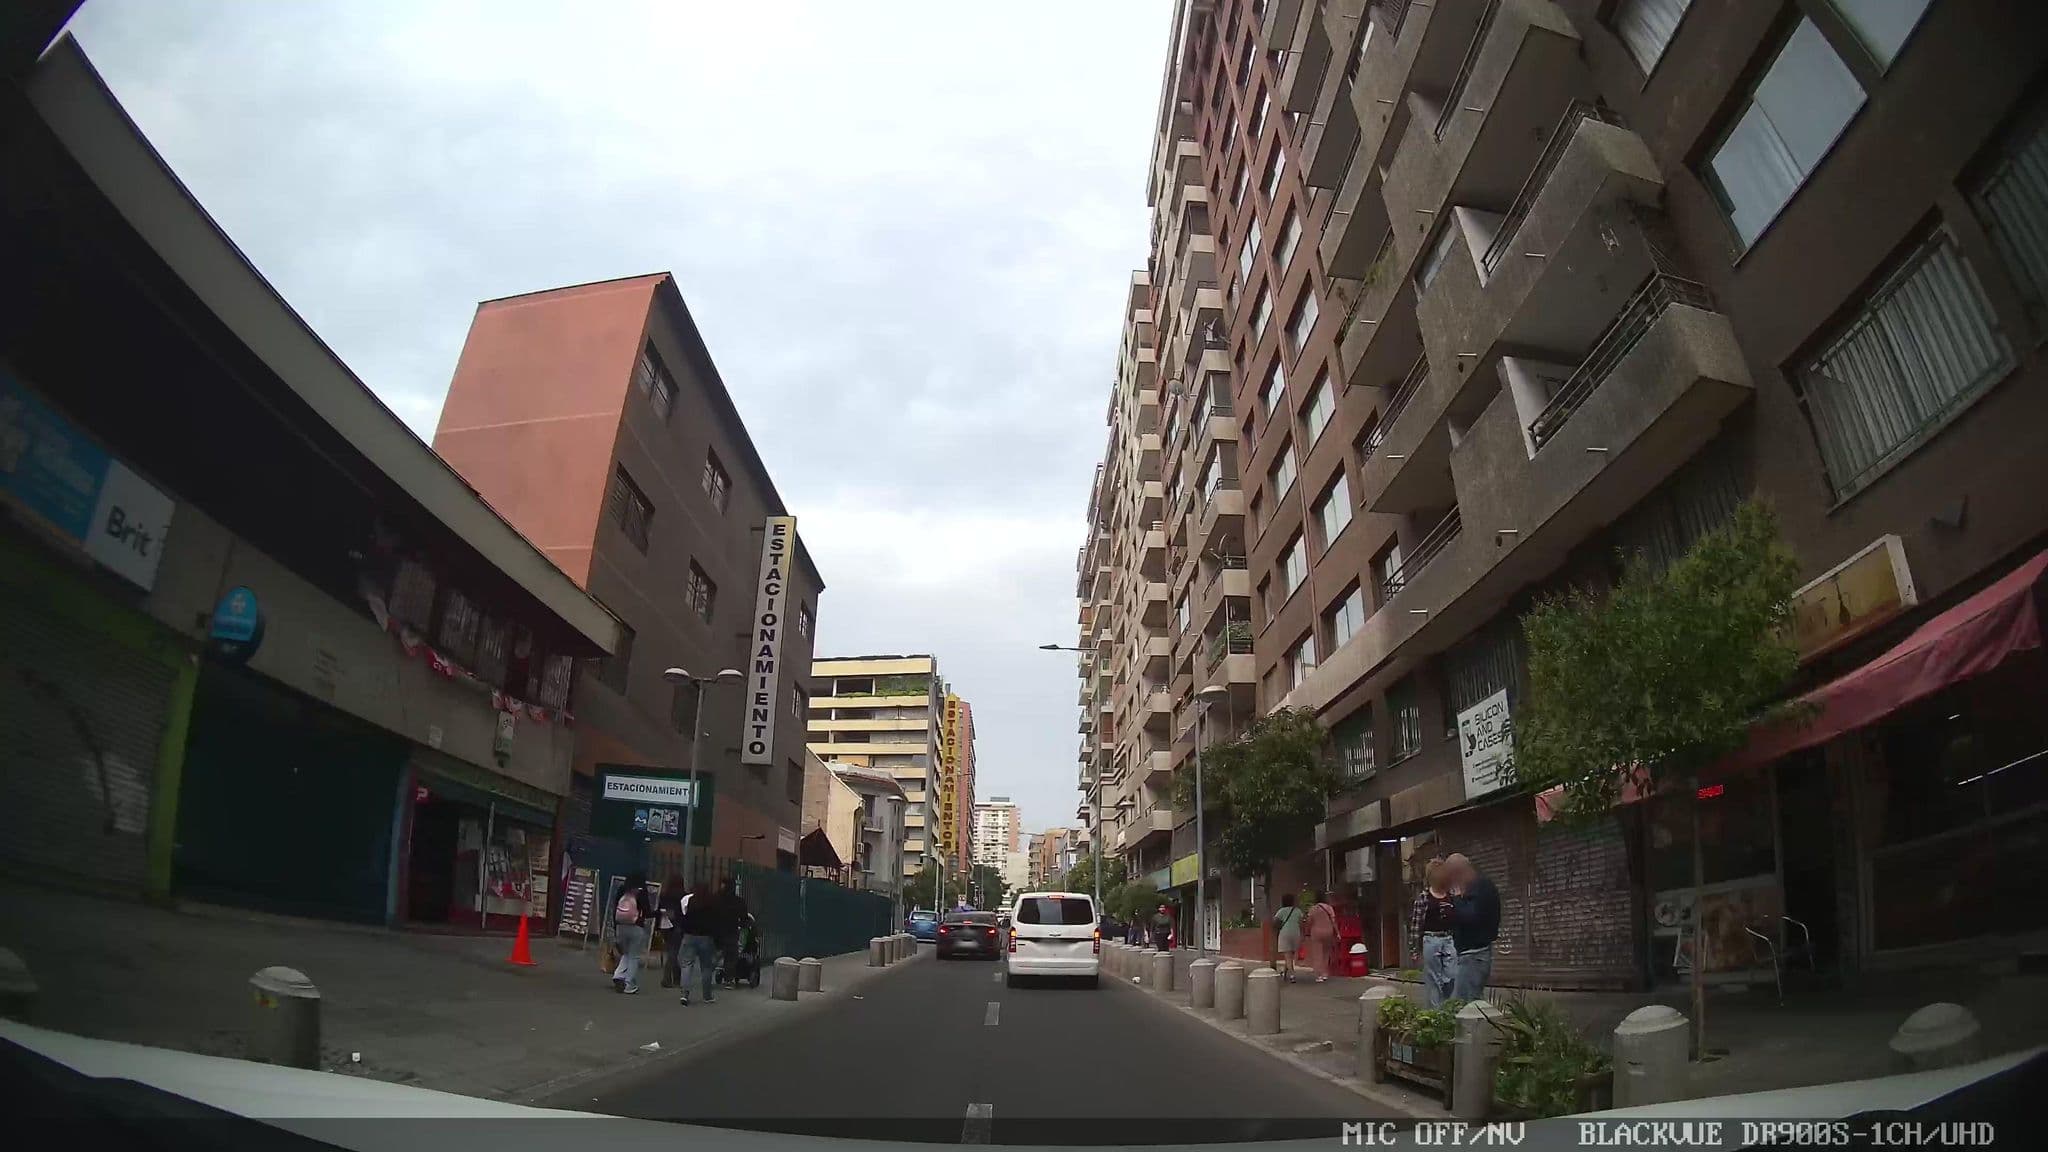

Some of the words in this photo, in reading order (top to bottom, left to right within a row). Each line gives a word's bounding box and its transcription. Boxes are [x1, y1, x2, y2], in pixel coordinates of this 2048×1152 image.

[105, 505, 153, 557] Brit
[749, 524, 786, 755] ESTACIONAMIENTO
[1474, 701, 1504, 726] SILICON
[1477, 721, 1493, 738] AND
[607, 782, 691, 797] ESTACIONAMIENT
